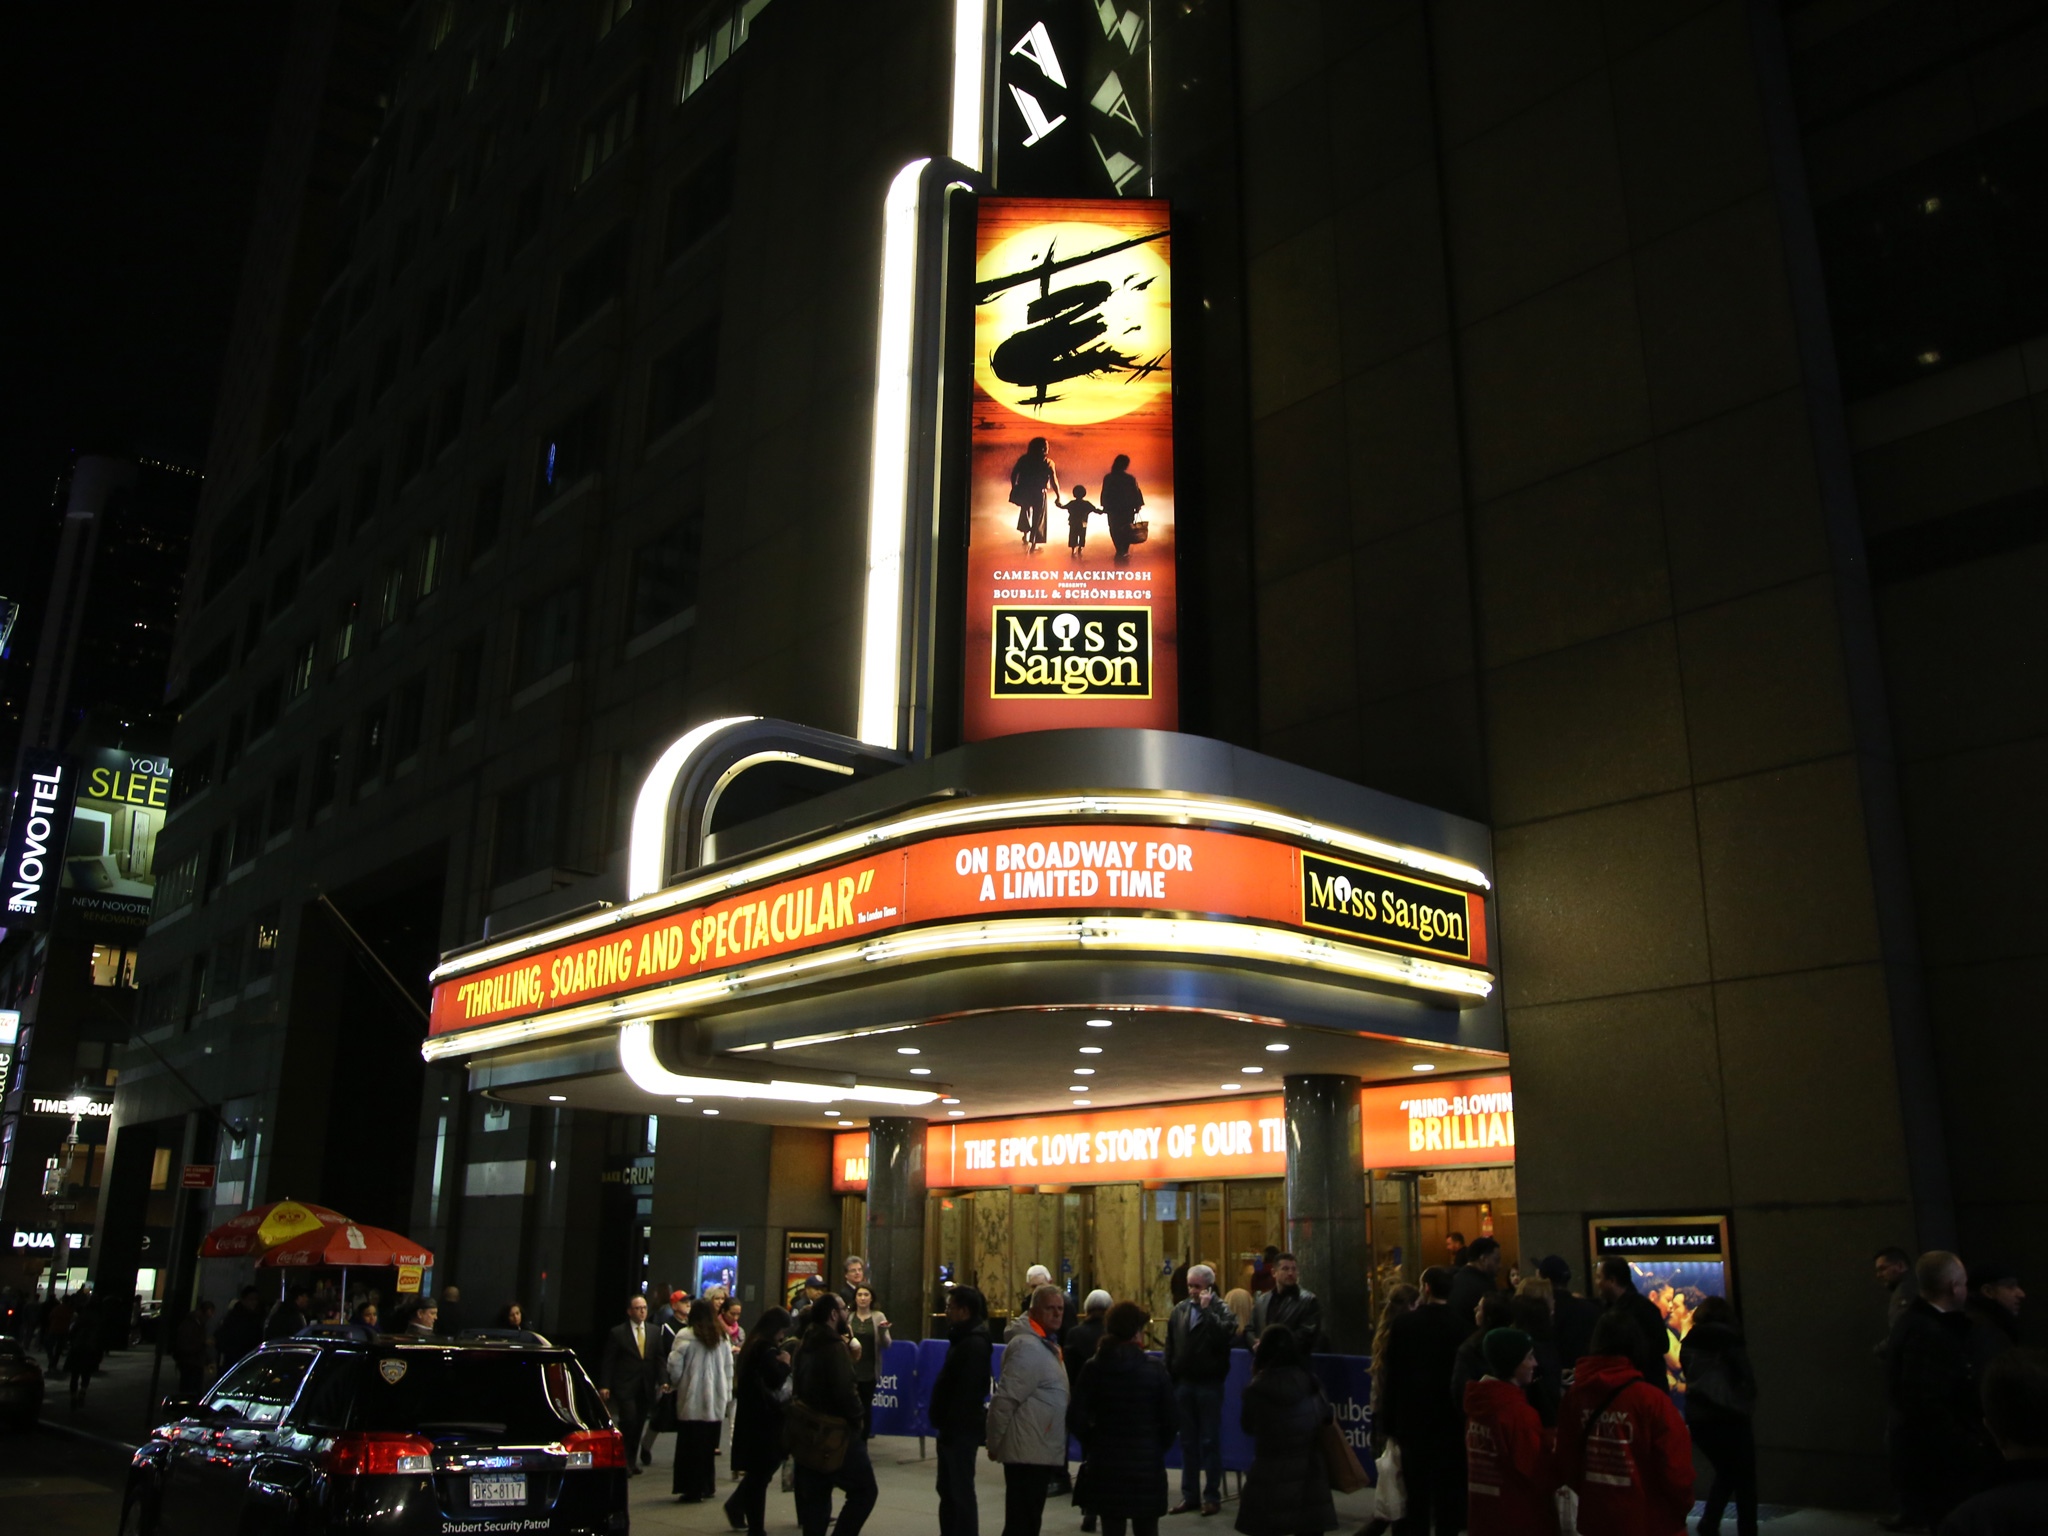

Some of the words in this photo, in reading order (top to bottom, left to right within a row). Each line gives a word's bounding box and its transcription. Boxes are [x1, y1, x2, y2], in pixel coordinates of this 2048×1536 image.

[993, 571, 1059, 580] CAMERON
[1063, 571, 1152, 581] MACKINTOSH
[993, 589, 1048, 599] BOUBLIL
[1051, 589, 1061, 599] &
[1065, 588, 1152, 599] SCHÖNBERG'S
[1005, 649, 1141, 694] Saigon
[88, 767, 169, 807] SLEE
[9, 765, 62, 907] NOVOTEL
[955, 846, 988, 876] ON
[996, 841, 1137, 872] BROADWAY
[1146, 842, 1193, 872] FOR
[979, 874, 996, 902] A
[1003, 869, 1099, 900] LIMITED
[1106, 869, 1166, 899] TIME
[8, 903, 35, 914] HOTEL
[71, 896, 99, 908] NEW
[858, 911, 866, 924] The
[866, 907, 883, 922] London
[883, 906, 897, 918] Times
[1381, 889, 1465, 942] Saigon
[457, 964, 545, 1019] "THRILLING,
[550, 939, 633, 998] SOARING
[636, 925, 684, 978] AND
[689, 869, 875, 965] SPECTACULAR"
[964, 1139, 996, 1170] THE
[1000, 1136, 1039, 1168] EPIC
[1042, 1132, 1090, 1166] LOVE
[1094, 1127, 1162, 1164] STORY
[1166, 1124, 1197, 1158] OF
[1201, 1120, 1253, 1157] OUR
[844, 1157, 869, 1181] MA
[13, 1231, 82, 1249] DUAE
[1603, 1236, 1660, 1247] BROADWAY
[1665, 1234, 1715, 1246] THEATRE
[442, 1522, 484, 1534] Shubert
[484, 1520, 522, 1533] Security
[524, 1518, 550, 1530] Patrol
